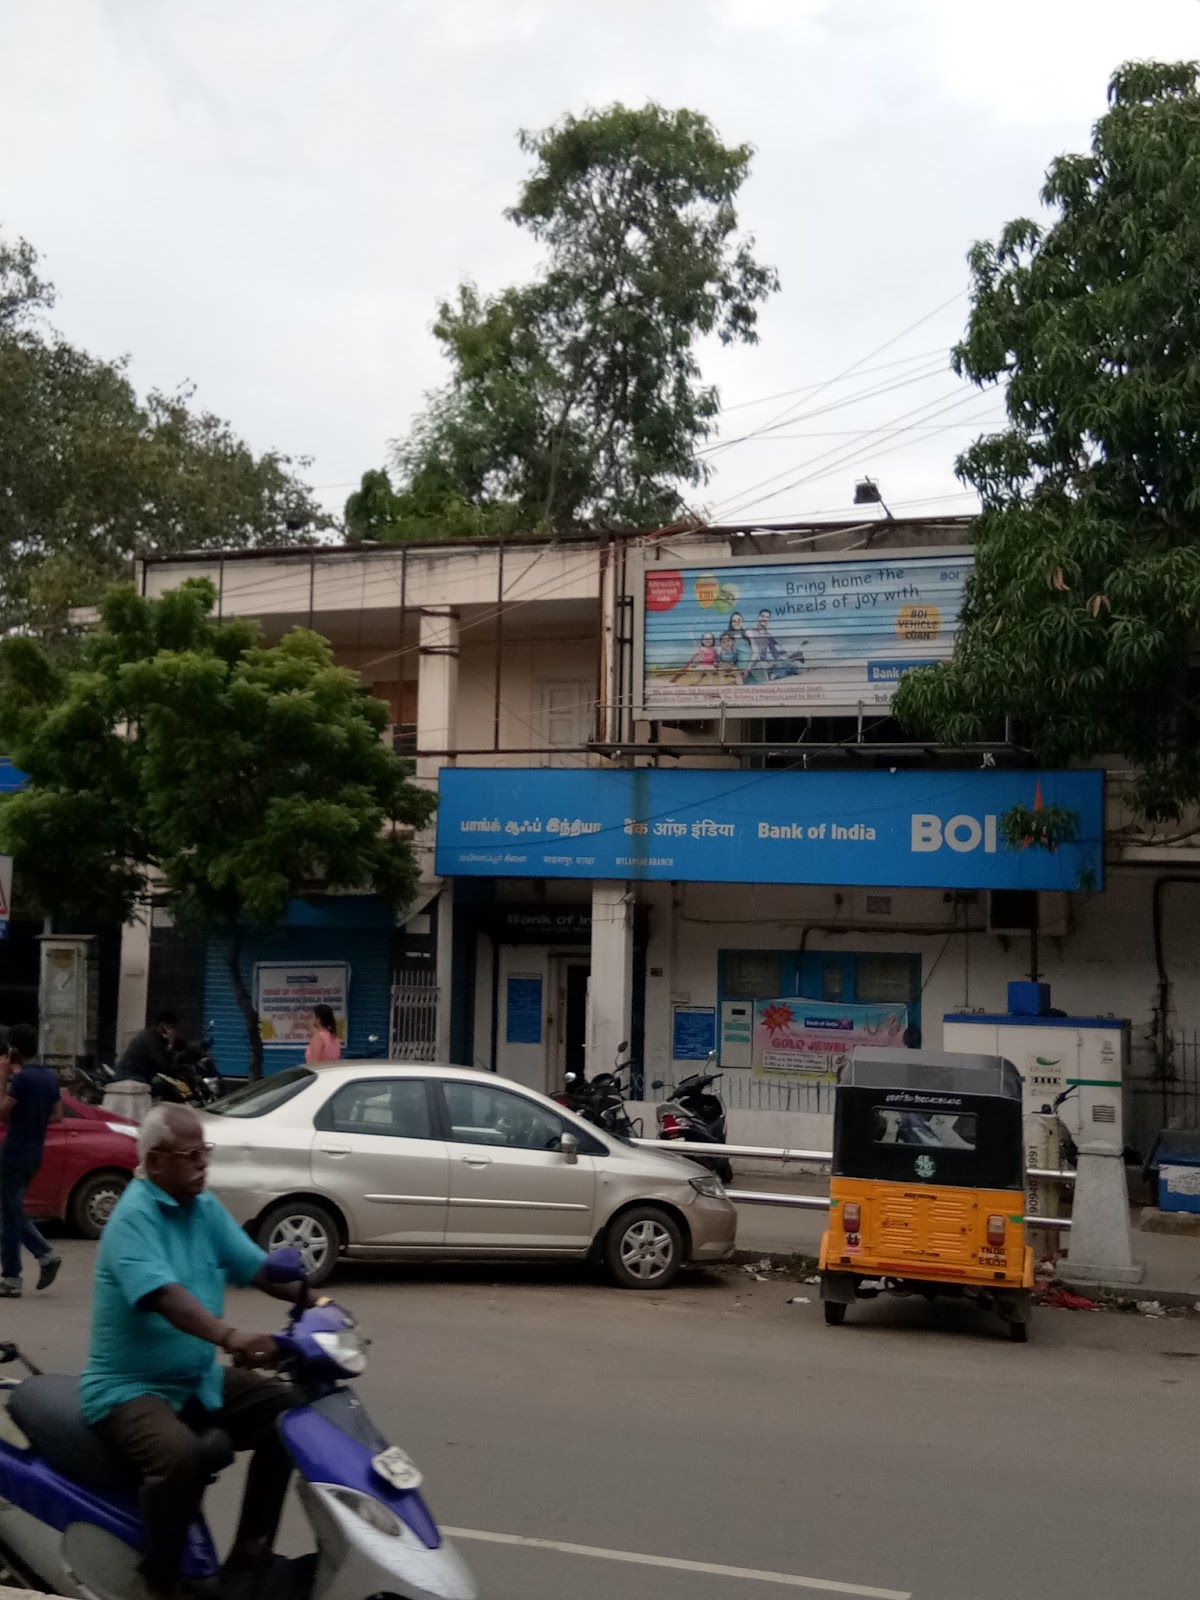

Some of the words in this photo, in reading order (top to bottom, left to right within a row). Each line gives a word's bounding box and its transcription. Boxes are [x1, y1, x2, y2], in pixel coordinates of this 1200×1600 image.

[786, 581, 826, 597] Bring
[831, 573, 873, 589] home
[878, 568, 905, 581] the
[940, 571, 960, 581] BOI
[775, 597, 827, 616] wheels
[832, 595, 847, 608] of
[855, 591, 879, 609] joy
[885, 584, 919, 601] with
[911, 610, 927, 618] BOI
[898, 620, 938, 629] VEHICLE
[873, 667, 899, 678] Bank
[459, 817, 501, 832] பாங்க்
[505, 817, 542, 836] ஆஃப்
[546, 817, 602, 837] இந்தியா
[691, 819, 735, 839] इंडिया
[758, 822, 802, 839] Bank
[807, 823, 827, 839] of
[831, 823, 876, 840] India
[911, 814, 997, 853] BOI
[507, 913, 552, 924] Bank
[556, 914, 574, 924] of
[771, 1038, 804, 1049] GOLD
